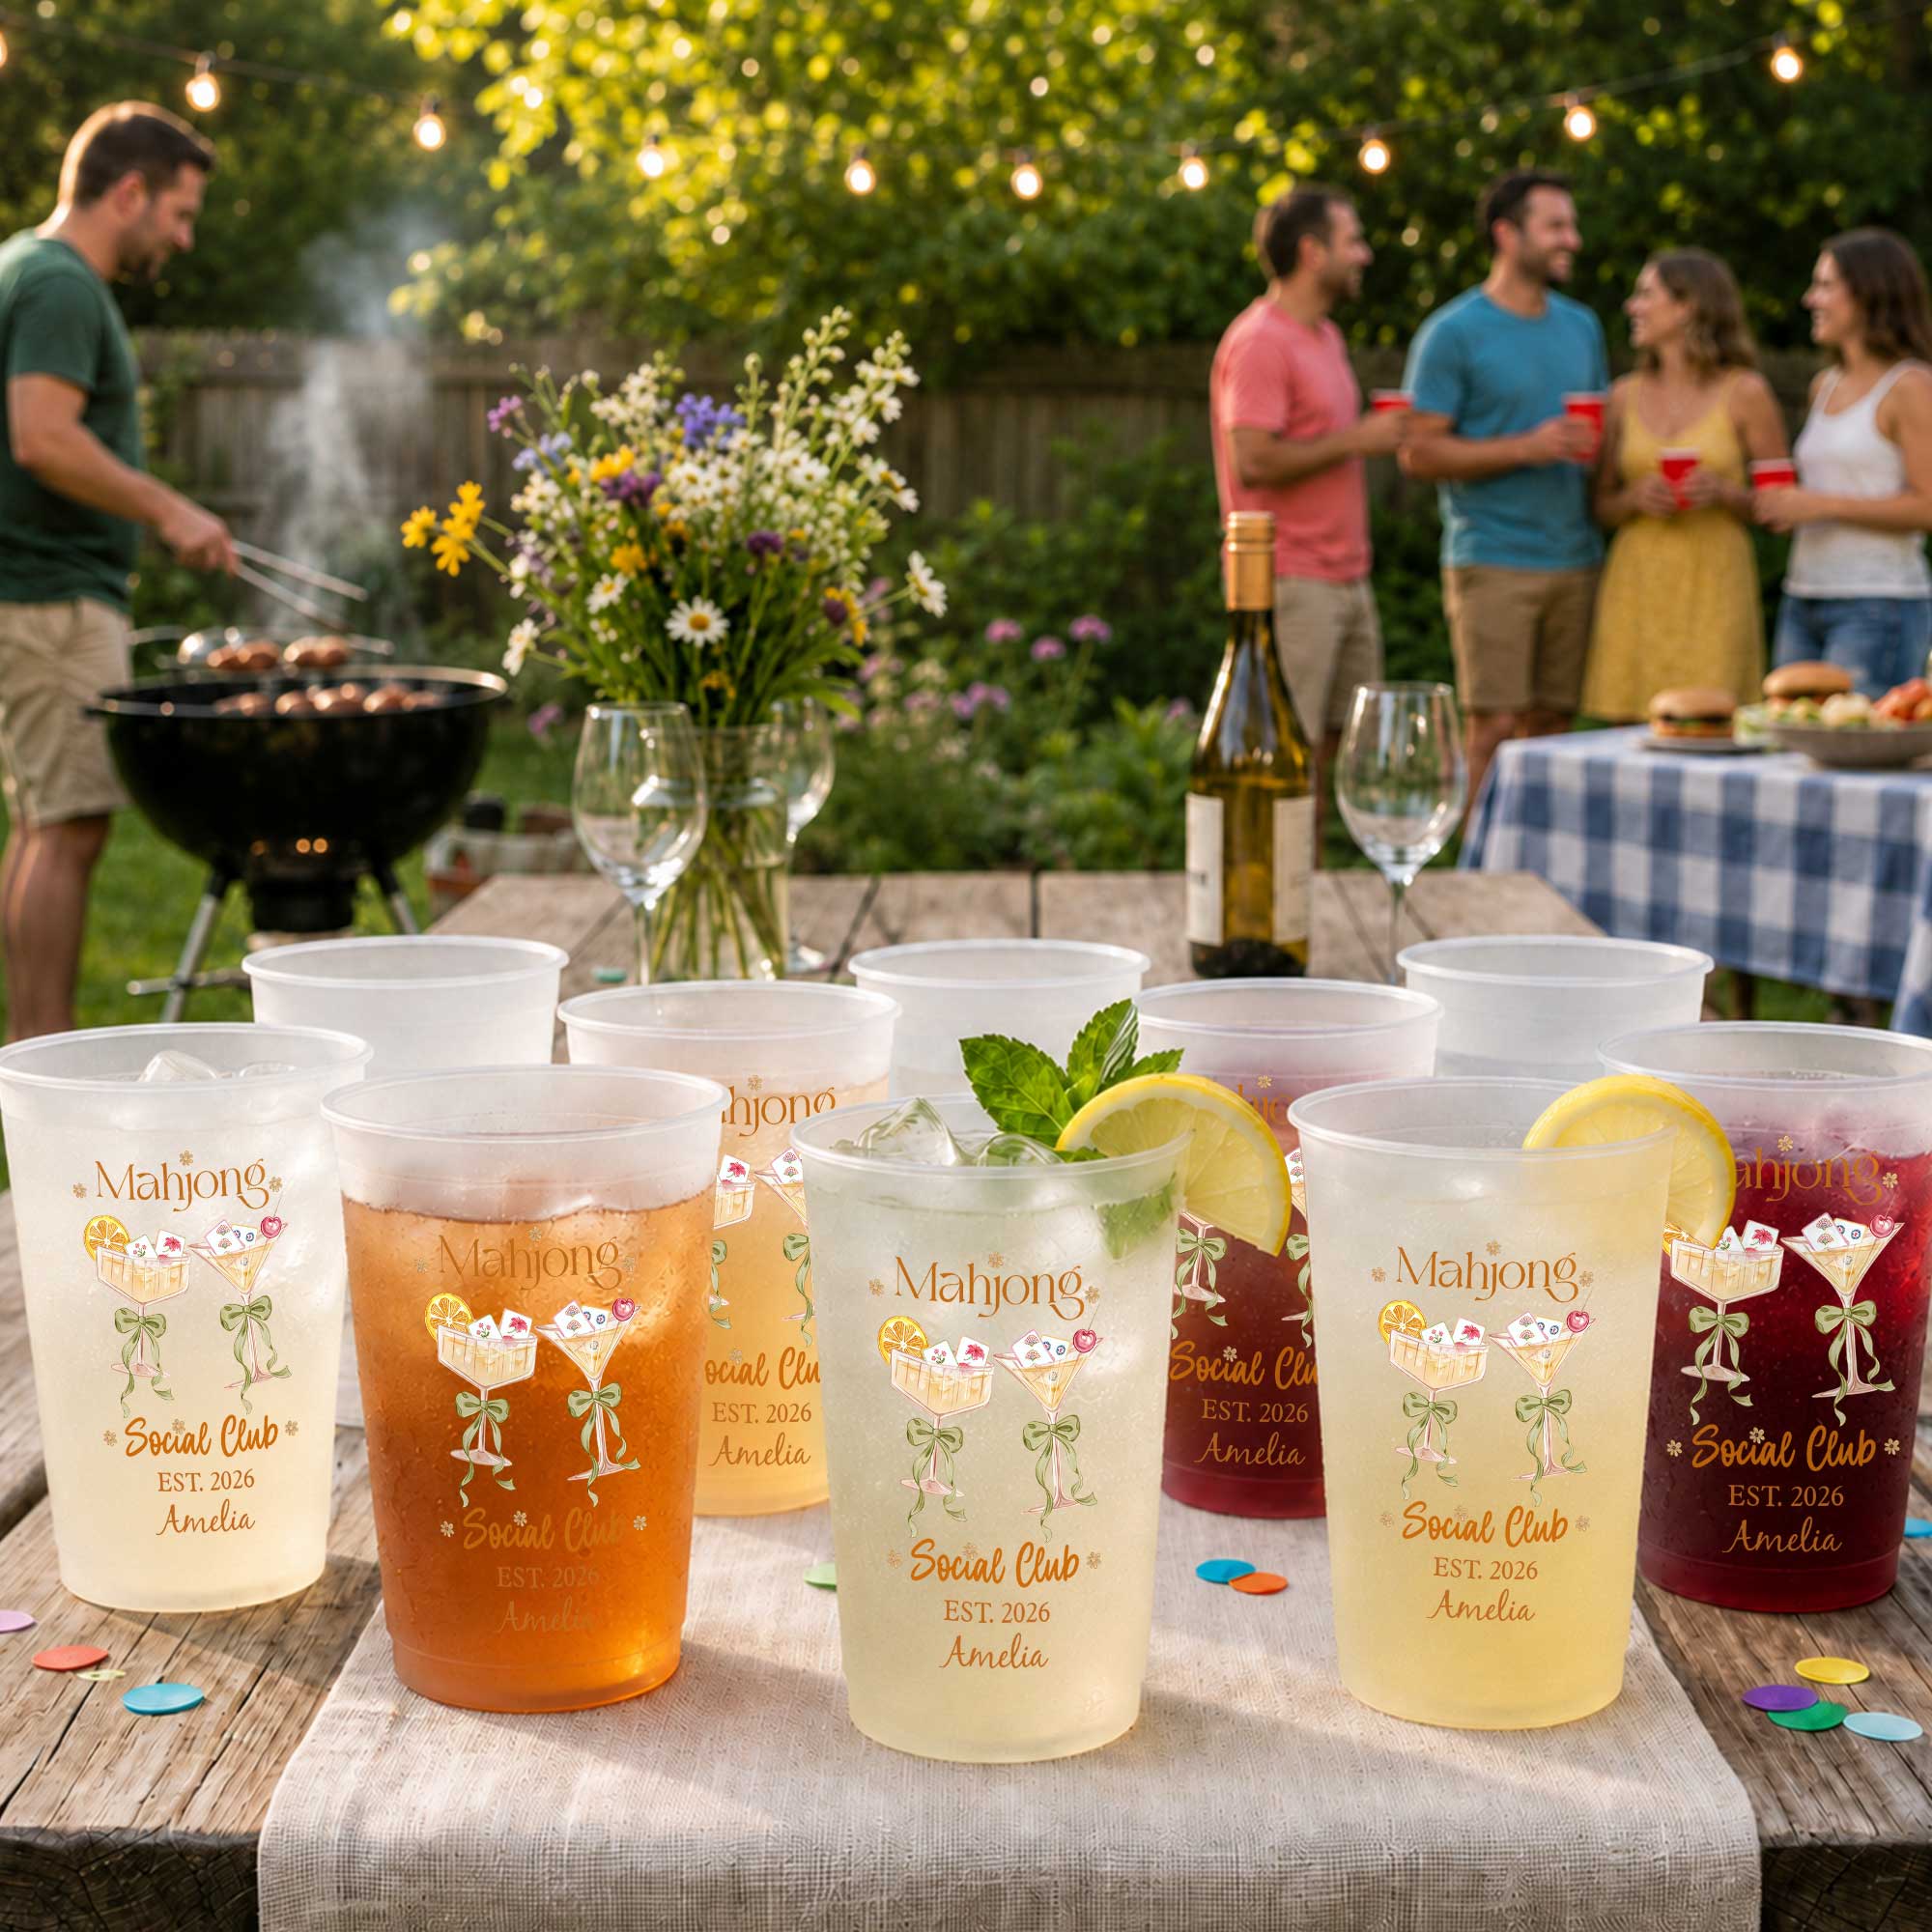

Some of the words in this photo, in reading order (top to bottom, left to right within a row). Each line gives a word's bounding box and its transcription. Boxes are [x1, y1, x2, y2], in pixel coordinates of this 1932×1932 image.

[720, 1086, 837, 1137] hjon
[95, 1159, 270, 1212] Mahjong
[1736, 1147, 1883, 1206] ahjong
[439, 1235, 623, 1291] Mahjong
[1397, 1246, 1579, 1303] Mahjong
[895, 1255, 1085, 1321] Mahjong
[704, 1351, 770, 1387] ocial
[779, 1346, 821, 1390] Clu
[1168, 1340, 1265, 1386] Social
[1274, 1346, 1319, 1390] Clu
[711, 1402, 759, 1424] EST.
[765, 1402, 812, 1424] 2026
[1201, 1398, 1252, 1423] EST.
[1259, 1403, 1309, 1423] 2026
[125, 1415, 212, 1457] Social
[220, 1414, 279, 1458] Club
[708, 1432, 811, 1467] Amelia
[1193, 1431, 1306, 1466] Amelia
[1691, 1423, 1796, 1468] Social
[1805, 1424, 1877, 1472] Club
[156, 1471, 204, 1493] EST.
[210, 1468, 256, 1492] 2026
[1727, 1485, 1783, 1508] EST.
[1791, 1484, 1845, 1508] 2026
[156, 1498, 257, 1537] Amelia
[463, 1507, 555, 1550] Social
[564, 1506, 627, 1552] Club
[1402, 1500, 1495, 1545] Social
[1504, 1504, 1570, 1548] Club
[1721, 1516, 1844, 1554] Amelia
[497, 1566, 546, 1590] EST.
[910, 1537, 1007, 1584] Social
[1015, 1541, 1081, 1589] Club
[1433, 1556, 1484, 1580] EST.
[1489, 1559, 1539, 1581] 2026
[943, 1599, 994, 1625] EST.
[1001, 1601, 1051, 1624] 2026
[1426, 1588, 1537, 1623] Amelia
[939, 1632, 1050, 1669] Amelia
